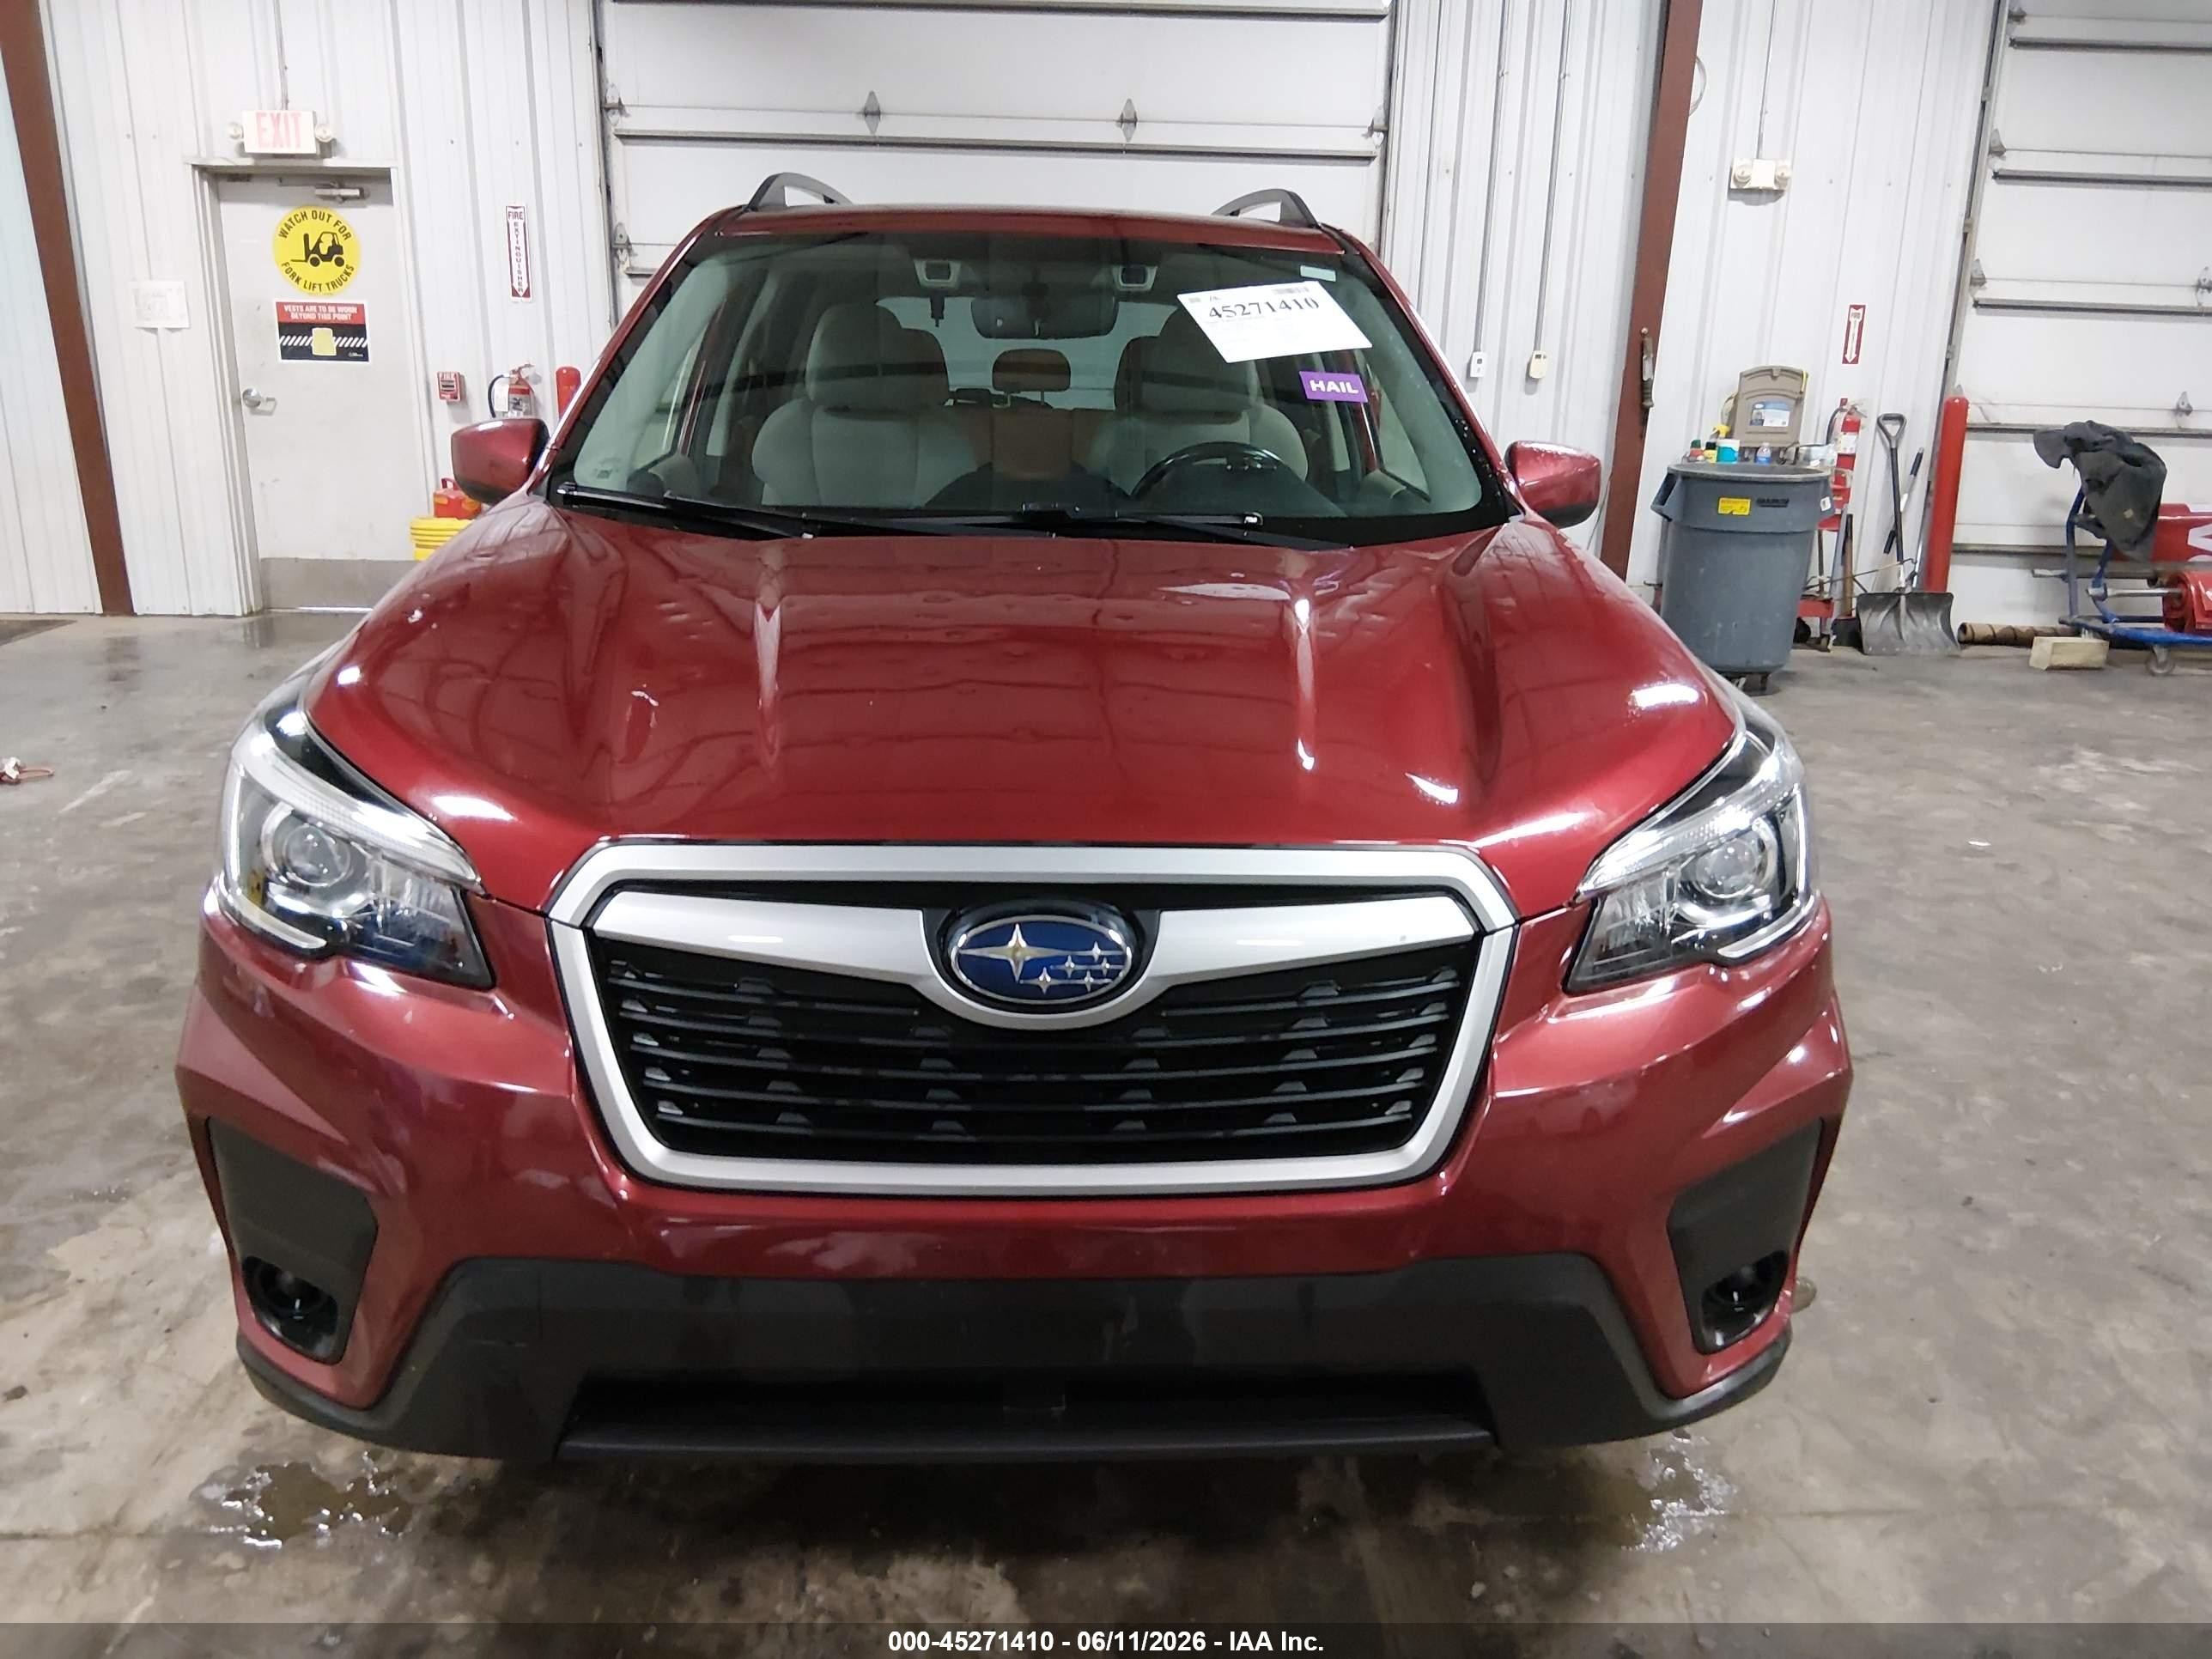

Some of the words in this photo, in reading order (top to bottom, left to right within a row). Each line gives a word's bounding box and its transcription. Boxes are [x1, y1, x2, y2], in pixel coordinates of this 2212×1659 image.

[256, 112, 301, 148] EXIT
[278, 210, 308, 239] WATCH
[311, 210, 332, 223] OUT
[333, 219, 352, 240] FOR
[507, 211, 524, 220] FIRE
[514, 222, 524, 293] EXTINGUISHER
[281, 261, 302, 284] FORK
[303, 279, 323, 292] LIFT
[325, 264, 355, 291] TRUCKS
[1209, 297, 1319, 319] 45271410
[1310, 380, 1358, 394] HAIL
